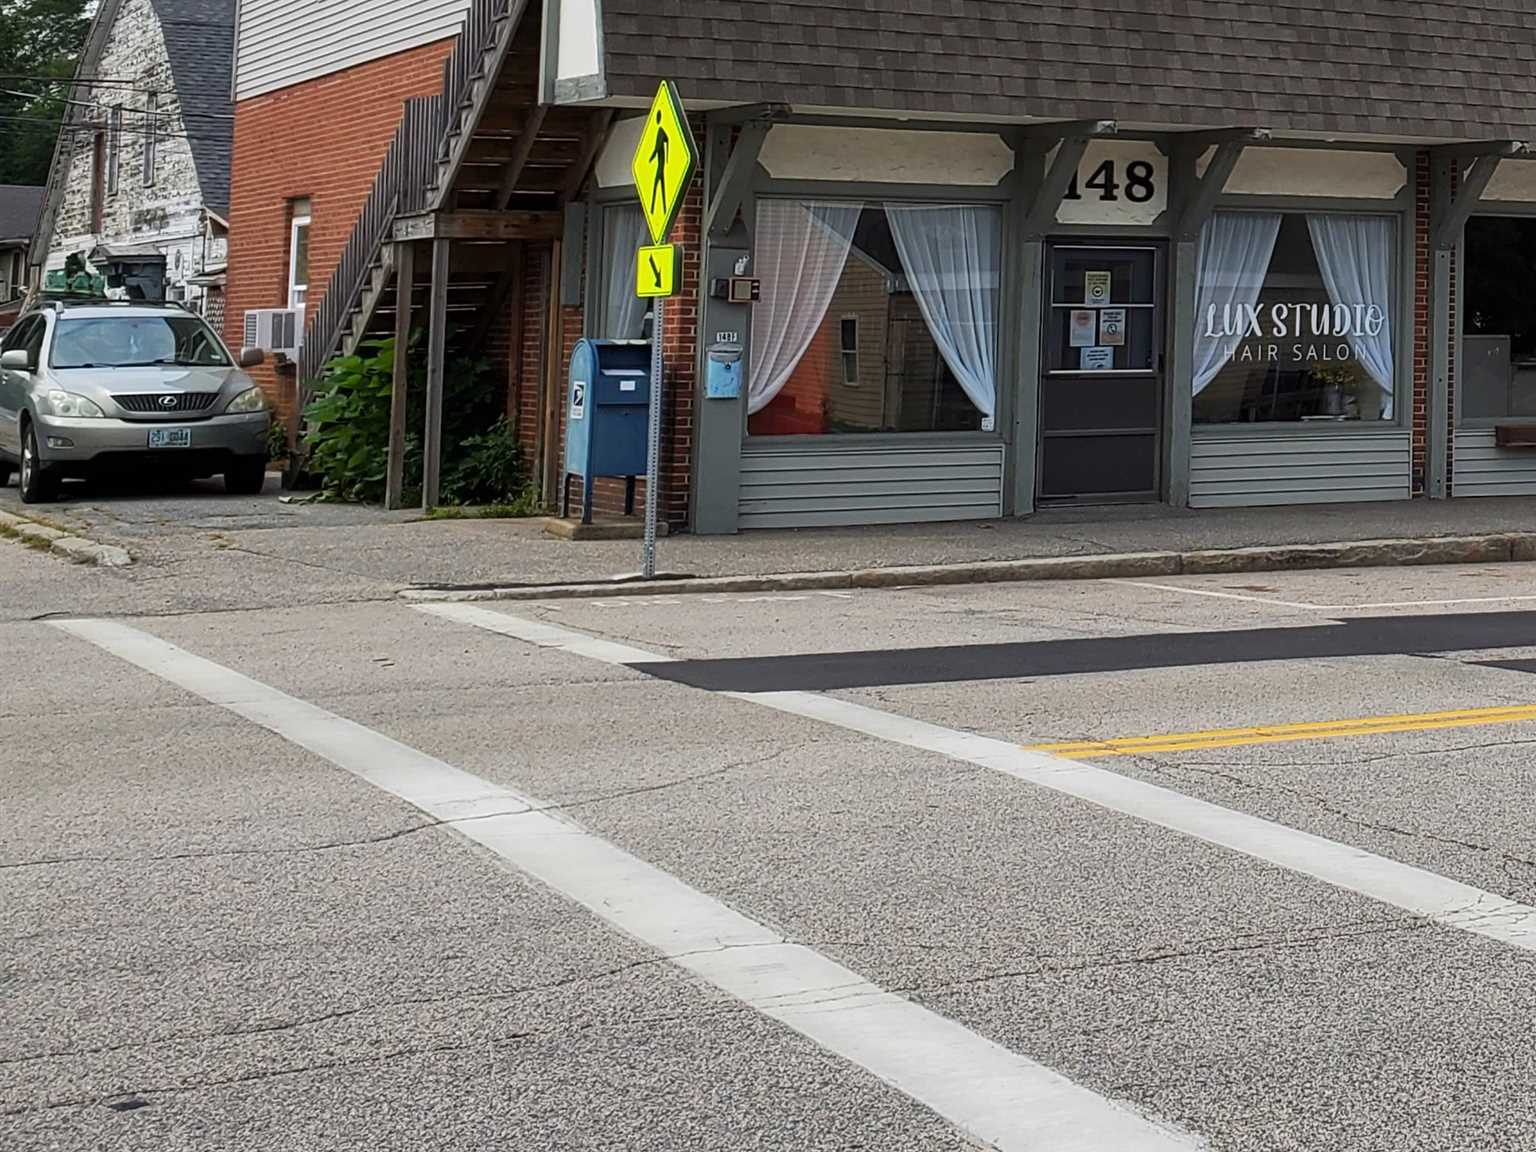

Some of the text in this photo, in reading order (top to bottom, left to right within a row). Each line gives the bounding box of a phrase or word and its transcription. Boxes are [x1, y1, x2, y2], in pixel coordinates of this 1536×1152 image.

[1204, 303, 1385, 338] LUX STUDIO
[1223, 344, 1368, 361] HAIR SALON
